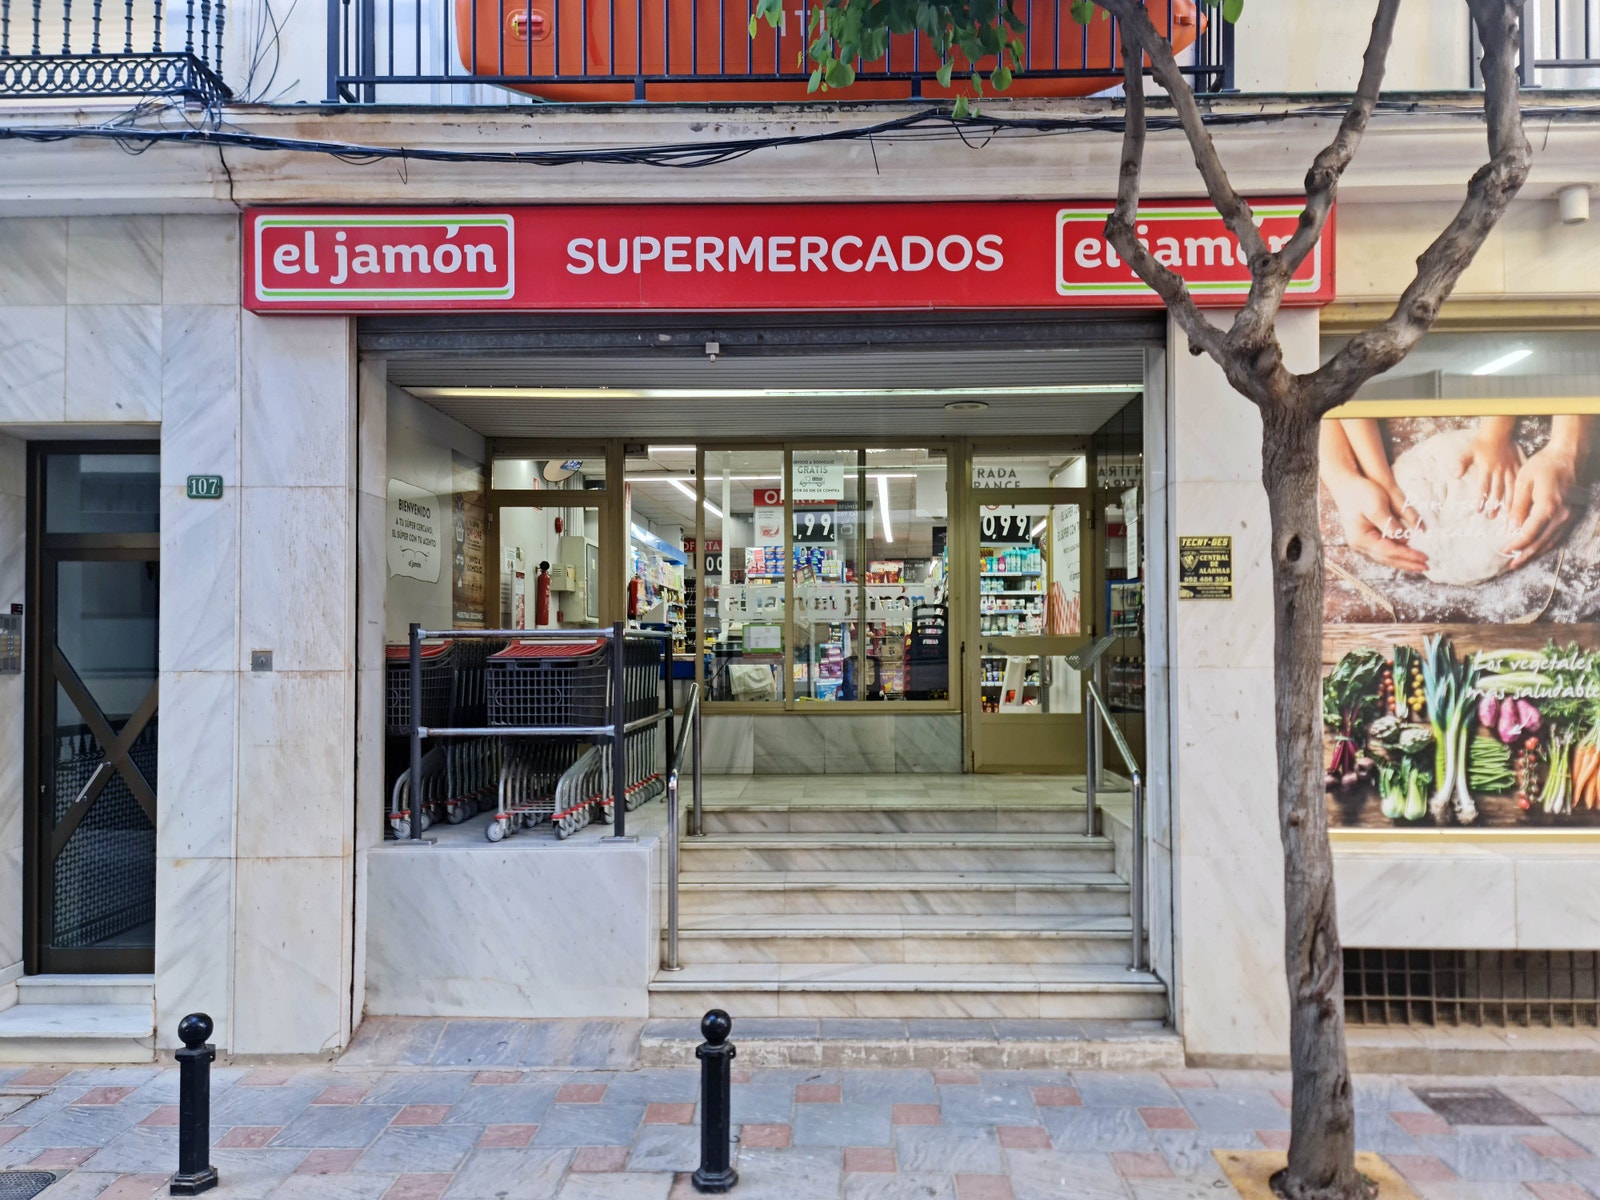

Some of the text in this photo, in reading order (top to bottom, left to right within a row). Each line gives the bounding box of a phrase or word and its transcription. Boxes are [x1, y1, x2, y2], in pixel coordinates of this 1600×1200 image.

[273, 226, 497, 285] el jamón
[565, 234, 1005, 275] SUPERMERCADOS
[797, 465, 828, 474] GRATIS
[973, 467, 1017, 479] RADA
[190, 478, 218, 496] 107
[399, 499, 431, 519] BIENVENIDO
[396, 529, 409, 541] SÚPER
[1473, 650, 1595, 679] Los vegetales
[1512, 673, 1600, 700] saludable
